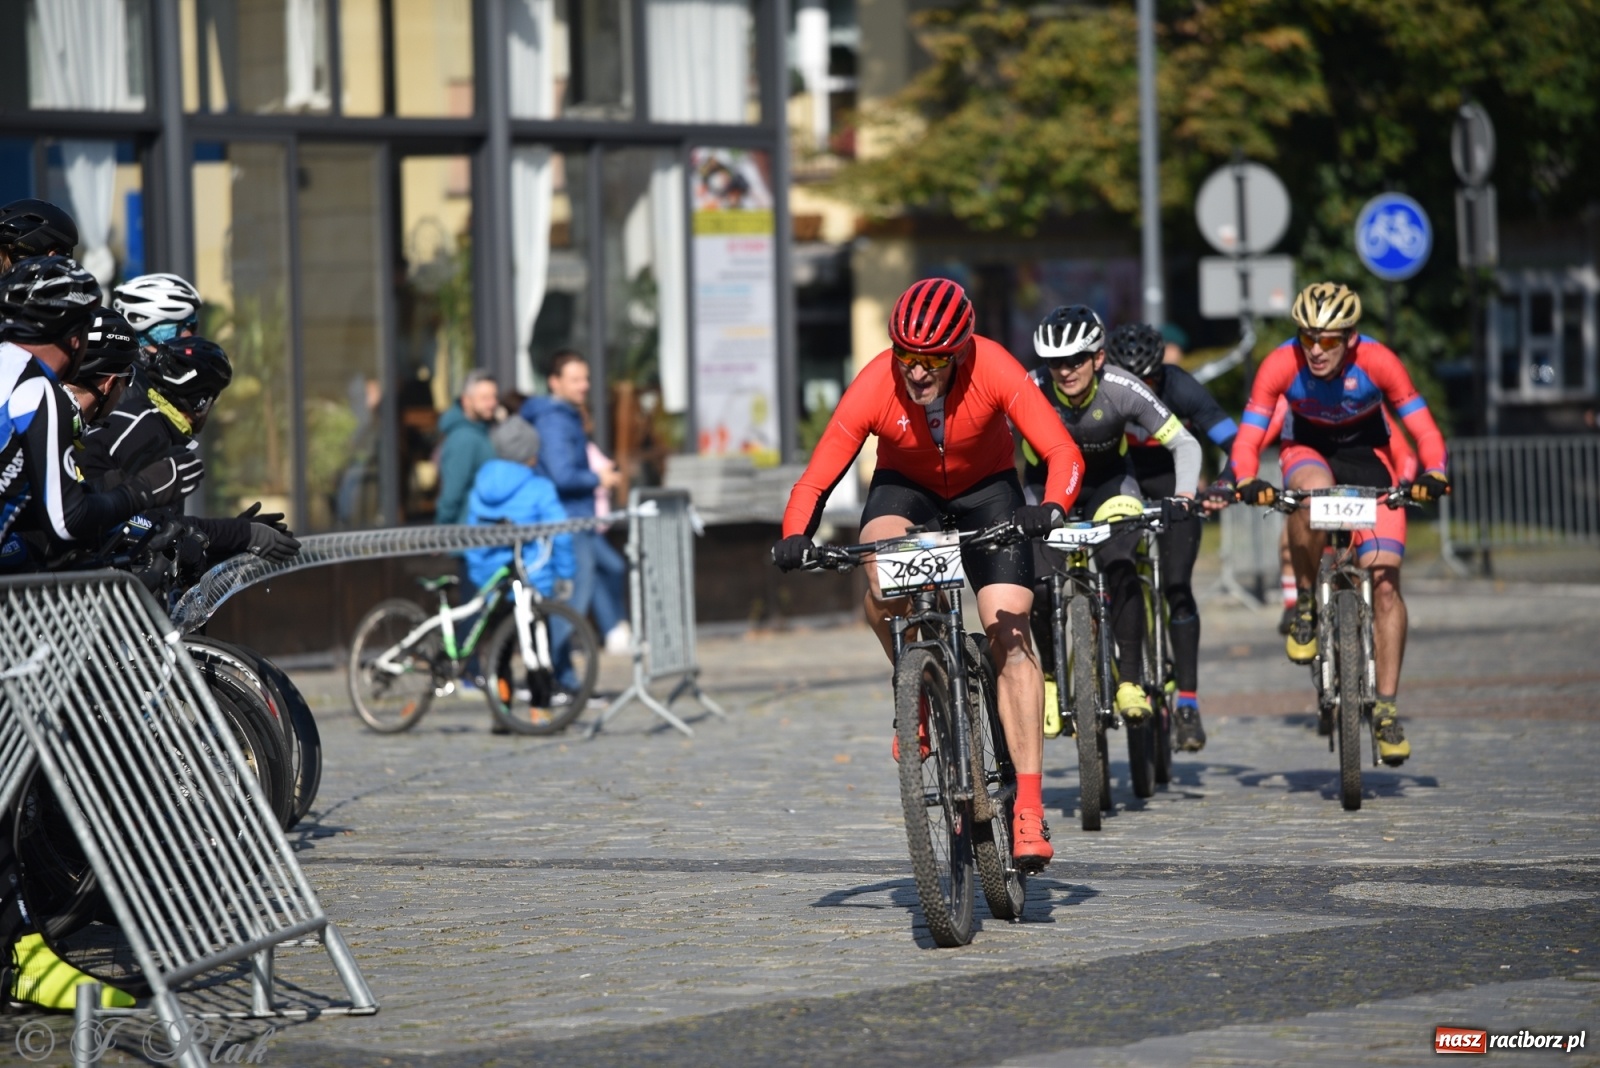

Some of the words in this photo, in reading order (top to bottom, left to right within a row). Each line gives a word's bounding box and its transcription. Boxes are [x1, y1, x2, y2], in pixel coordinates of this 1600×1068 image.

[114, 333, 131, 342] GIRO
[1103, 372, 1169, 419] garbaruk
[1323, 502, 1365, 517] 1167
[1058, 530, 1100, 543] 1187
[892, 556, 948, 579] 2658
